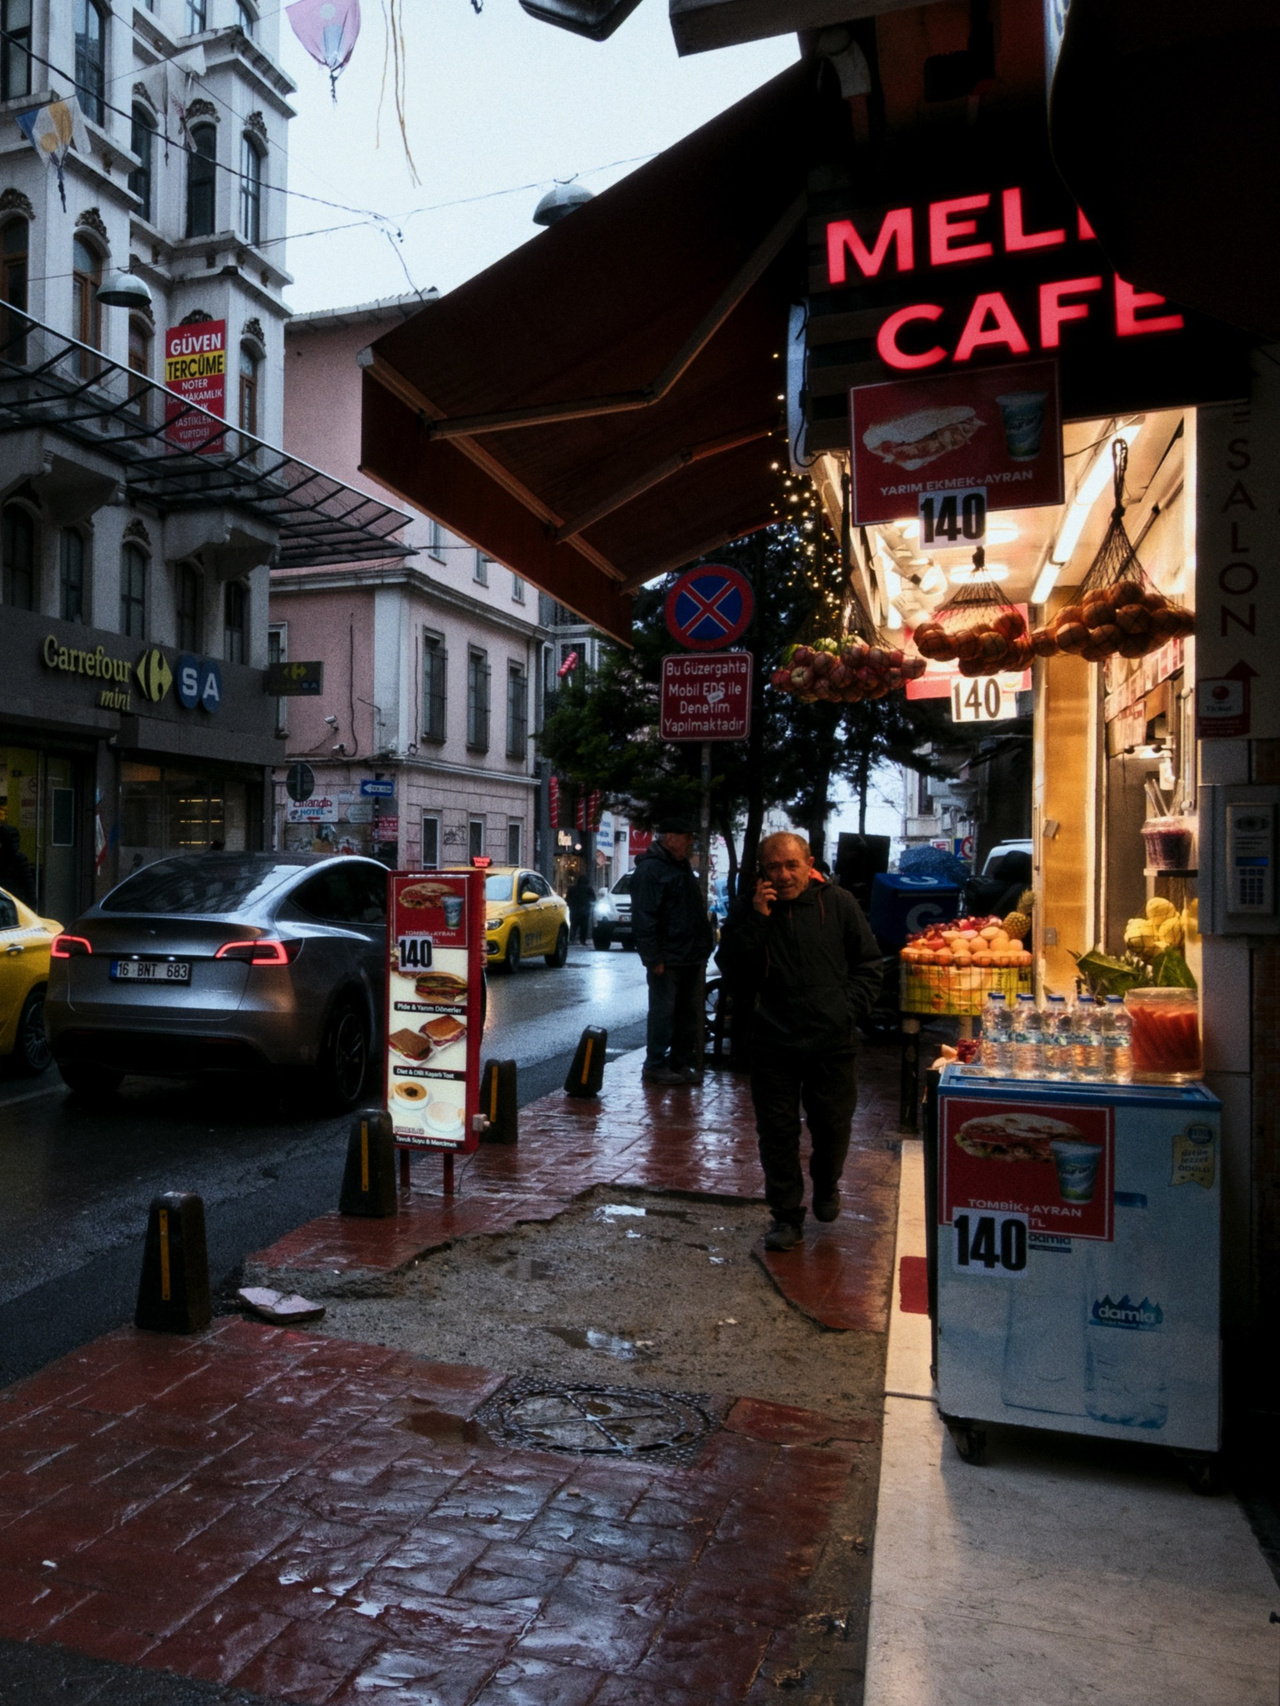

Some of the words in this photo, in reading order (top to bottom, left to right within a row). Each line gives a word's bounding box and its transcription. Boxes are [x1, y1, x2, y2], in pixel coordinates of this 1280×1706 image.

[877, 273, 1184, 370] CAFE
[171, 333, 222, 356] GÜVEN
[168, 354, 223, 380] TERCÜME
[182, 379, 208, 390] NOTER
[880, 481, 923, 496] YARIM
[920, 492, 986, 544] 140
[1218, 437, 1259, 637] SALON
[43, 634, 131, 684] Carrefour
[666, 662, 681, 676] Bu
[683, 660, 748, 678] Güzergahta
[100, 689, 132, 711] mini
[668, 683, 700, 697] Mobil
[702, 682, 726, 696] EDS
[728, 682, 742, 695] ile
[953, 678, 1001, 721] 140
[679, 701, 730, 715] Denetim
[664, 718, 745, 735] Yapılmaktadır
[399, 939, 432, 967] 140
[117, 963, 129, 976] 16
[137, 963, 158, 977] BNT
[167, 964, 188, 978] 683
[397, 1003, 410, 1011] Pide
[435, 1005, 462, 1014] Dönerler
[1030, 1217, 1046, 1228] TL
[954, 1214, 1027, 1271] 140
[1098, 1303, 1156, 1324] damla
